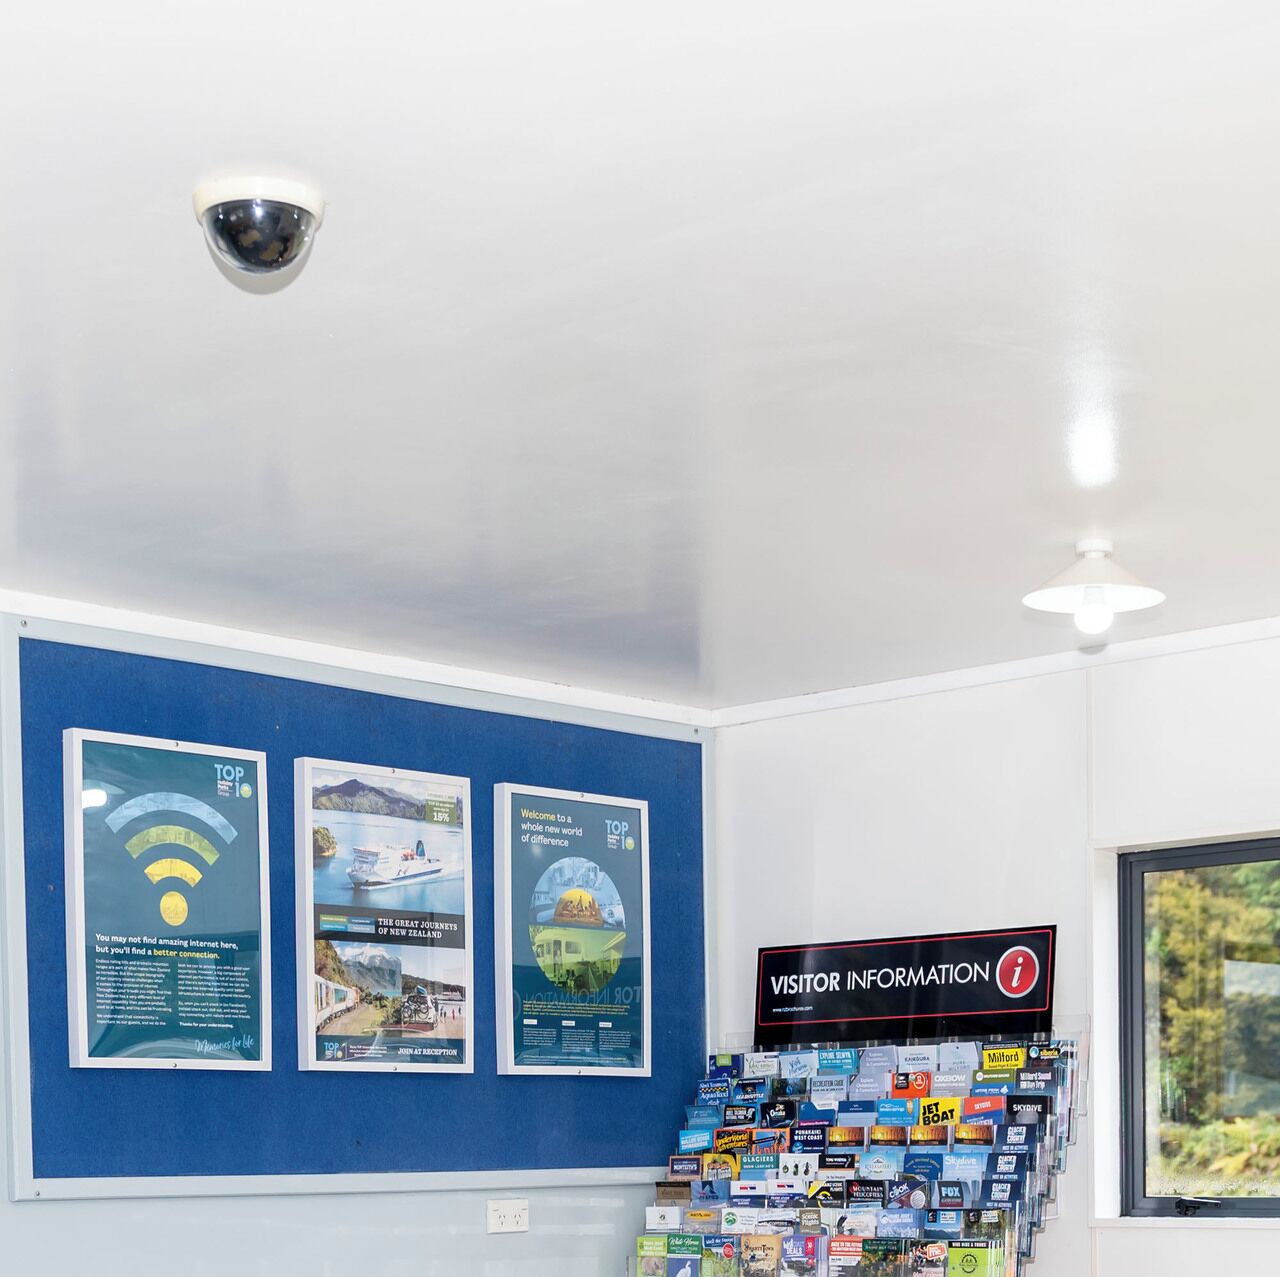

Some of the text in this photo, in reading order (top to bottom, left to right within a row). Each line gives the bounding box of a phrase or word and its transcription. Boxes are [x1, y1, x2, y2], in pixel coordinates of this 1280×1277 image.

[214, 763, 245, 782] TOP
[433, 812, 450, 823] 15%
[520, 808, 556, 821] Welcome
[556, 814, 565, 822] to
[521, 821, 583, 837] whole new world
[605, 820, 629, 835] TOP
[521, 834, 569, 847] of difference
[378, 918, 394, 926] THE
[395, 919, 419, 928] GREAT
[420, 921, 458, 931] JOURNEYS
[378, 927, 442, 938] OF NEW ZEALAND
[95, 933, 238, 950] You may not find amazing internet here,
[110, 945, 130, 955] you'll
[131, 947, 144, 955] find
[153, 948, 176, 957] better
[178, 950, 219, 959] connection.
[771, 961, 990, 995] VISITOR INFORMATION
[324, 1042, 339, 1050] TOP
[421, 1048, 458, 1056] RECEPTION
[988, 1051, 1019, 1063] Milford
[1020, 1072, 1038, 1080] Milford
[922, 1102, 939, 1116] JET
[1012, 1104, 1042, 1112] SKYDIVE
[922, 1108, 955, 1126] BOAT
[944, 1156, 977, 1168] Skydive
[941, 1187, 960, 1197] FOX
[787, 1247, 802, 1255] DEALS
